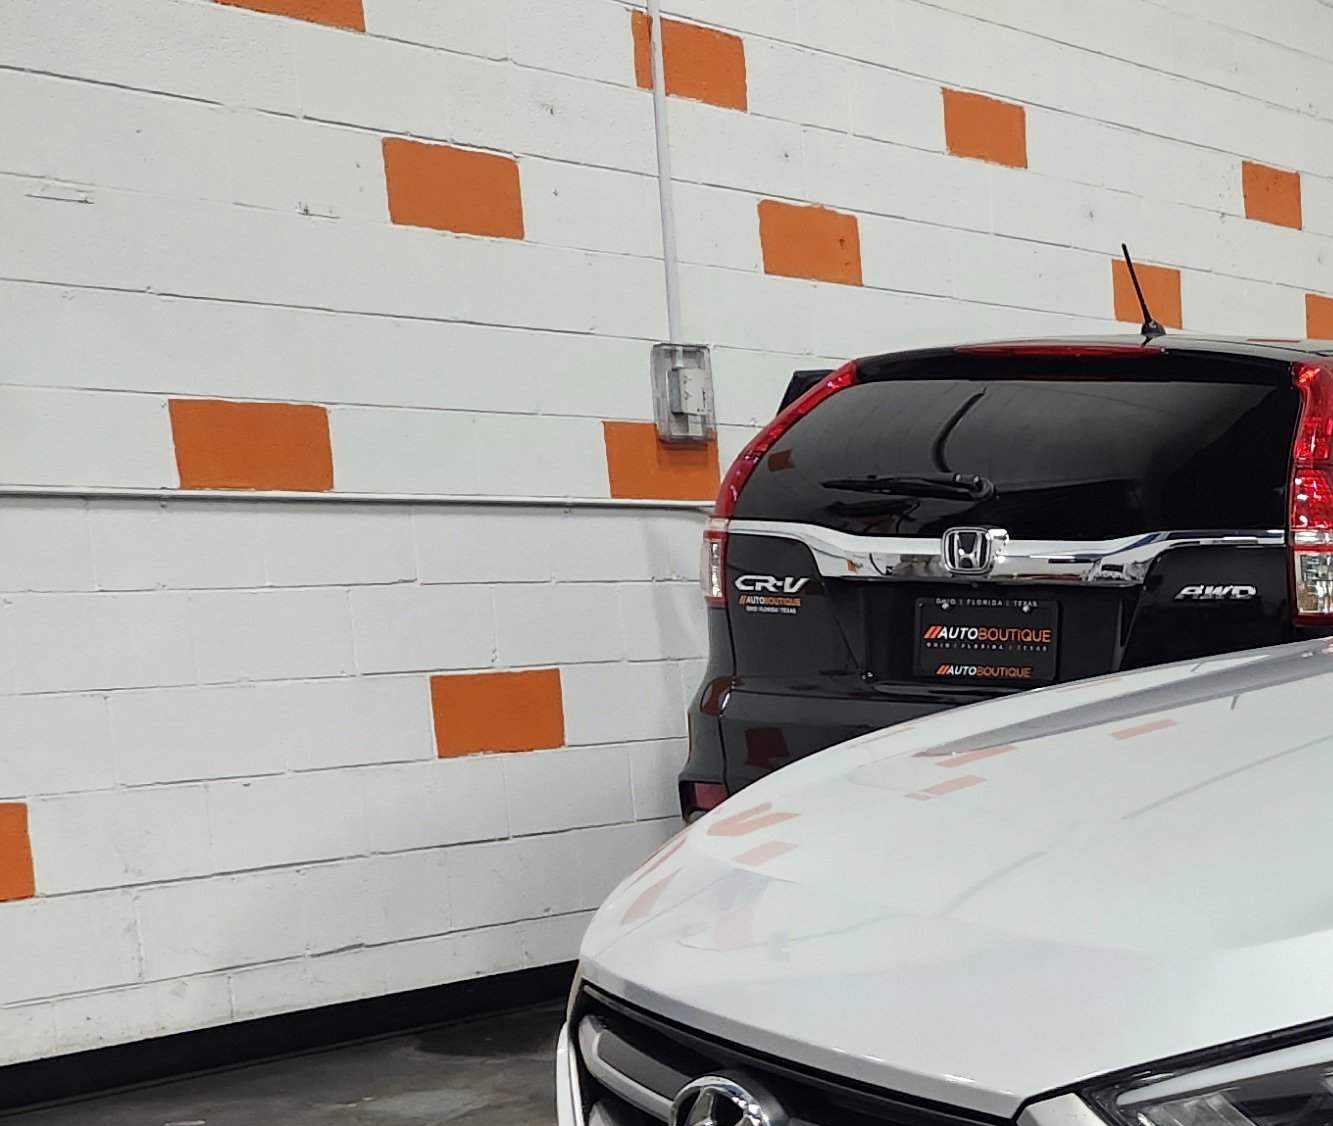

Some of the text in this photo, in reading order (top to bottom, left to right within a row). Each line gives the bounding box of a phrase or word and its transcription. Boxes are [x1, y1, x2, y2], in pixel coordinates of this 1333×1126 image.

[734, 575, 810, 593] CR-V
[1174, 584, 1257, 600] AWD
[1013, 600, 1038, 608] TEXAS
[937, 627, 1051, 643] AUTOBOUTIQUE
[946, 665, 1032, 678] AUTOBOUTIQUE
